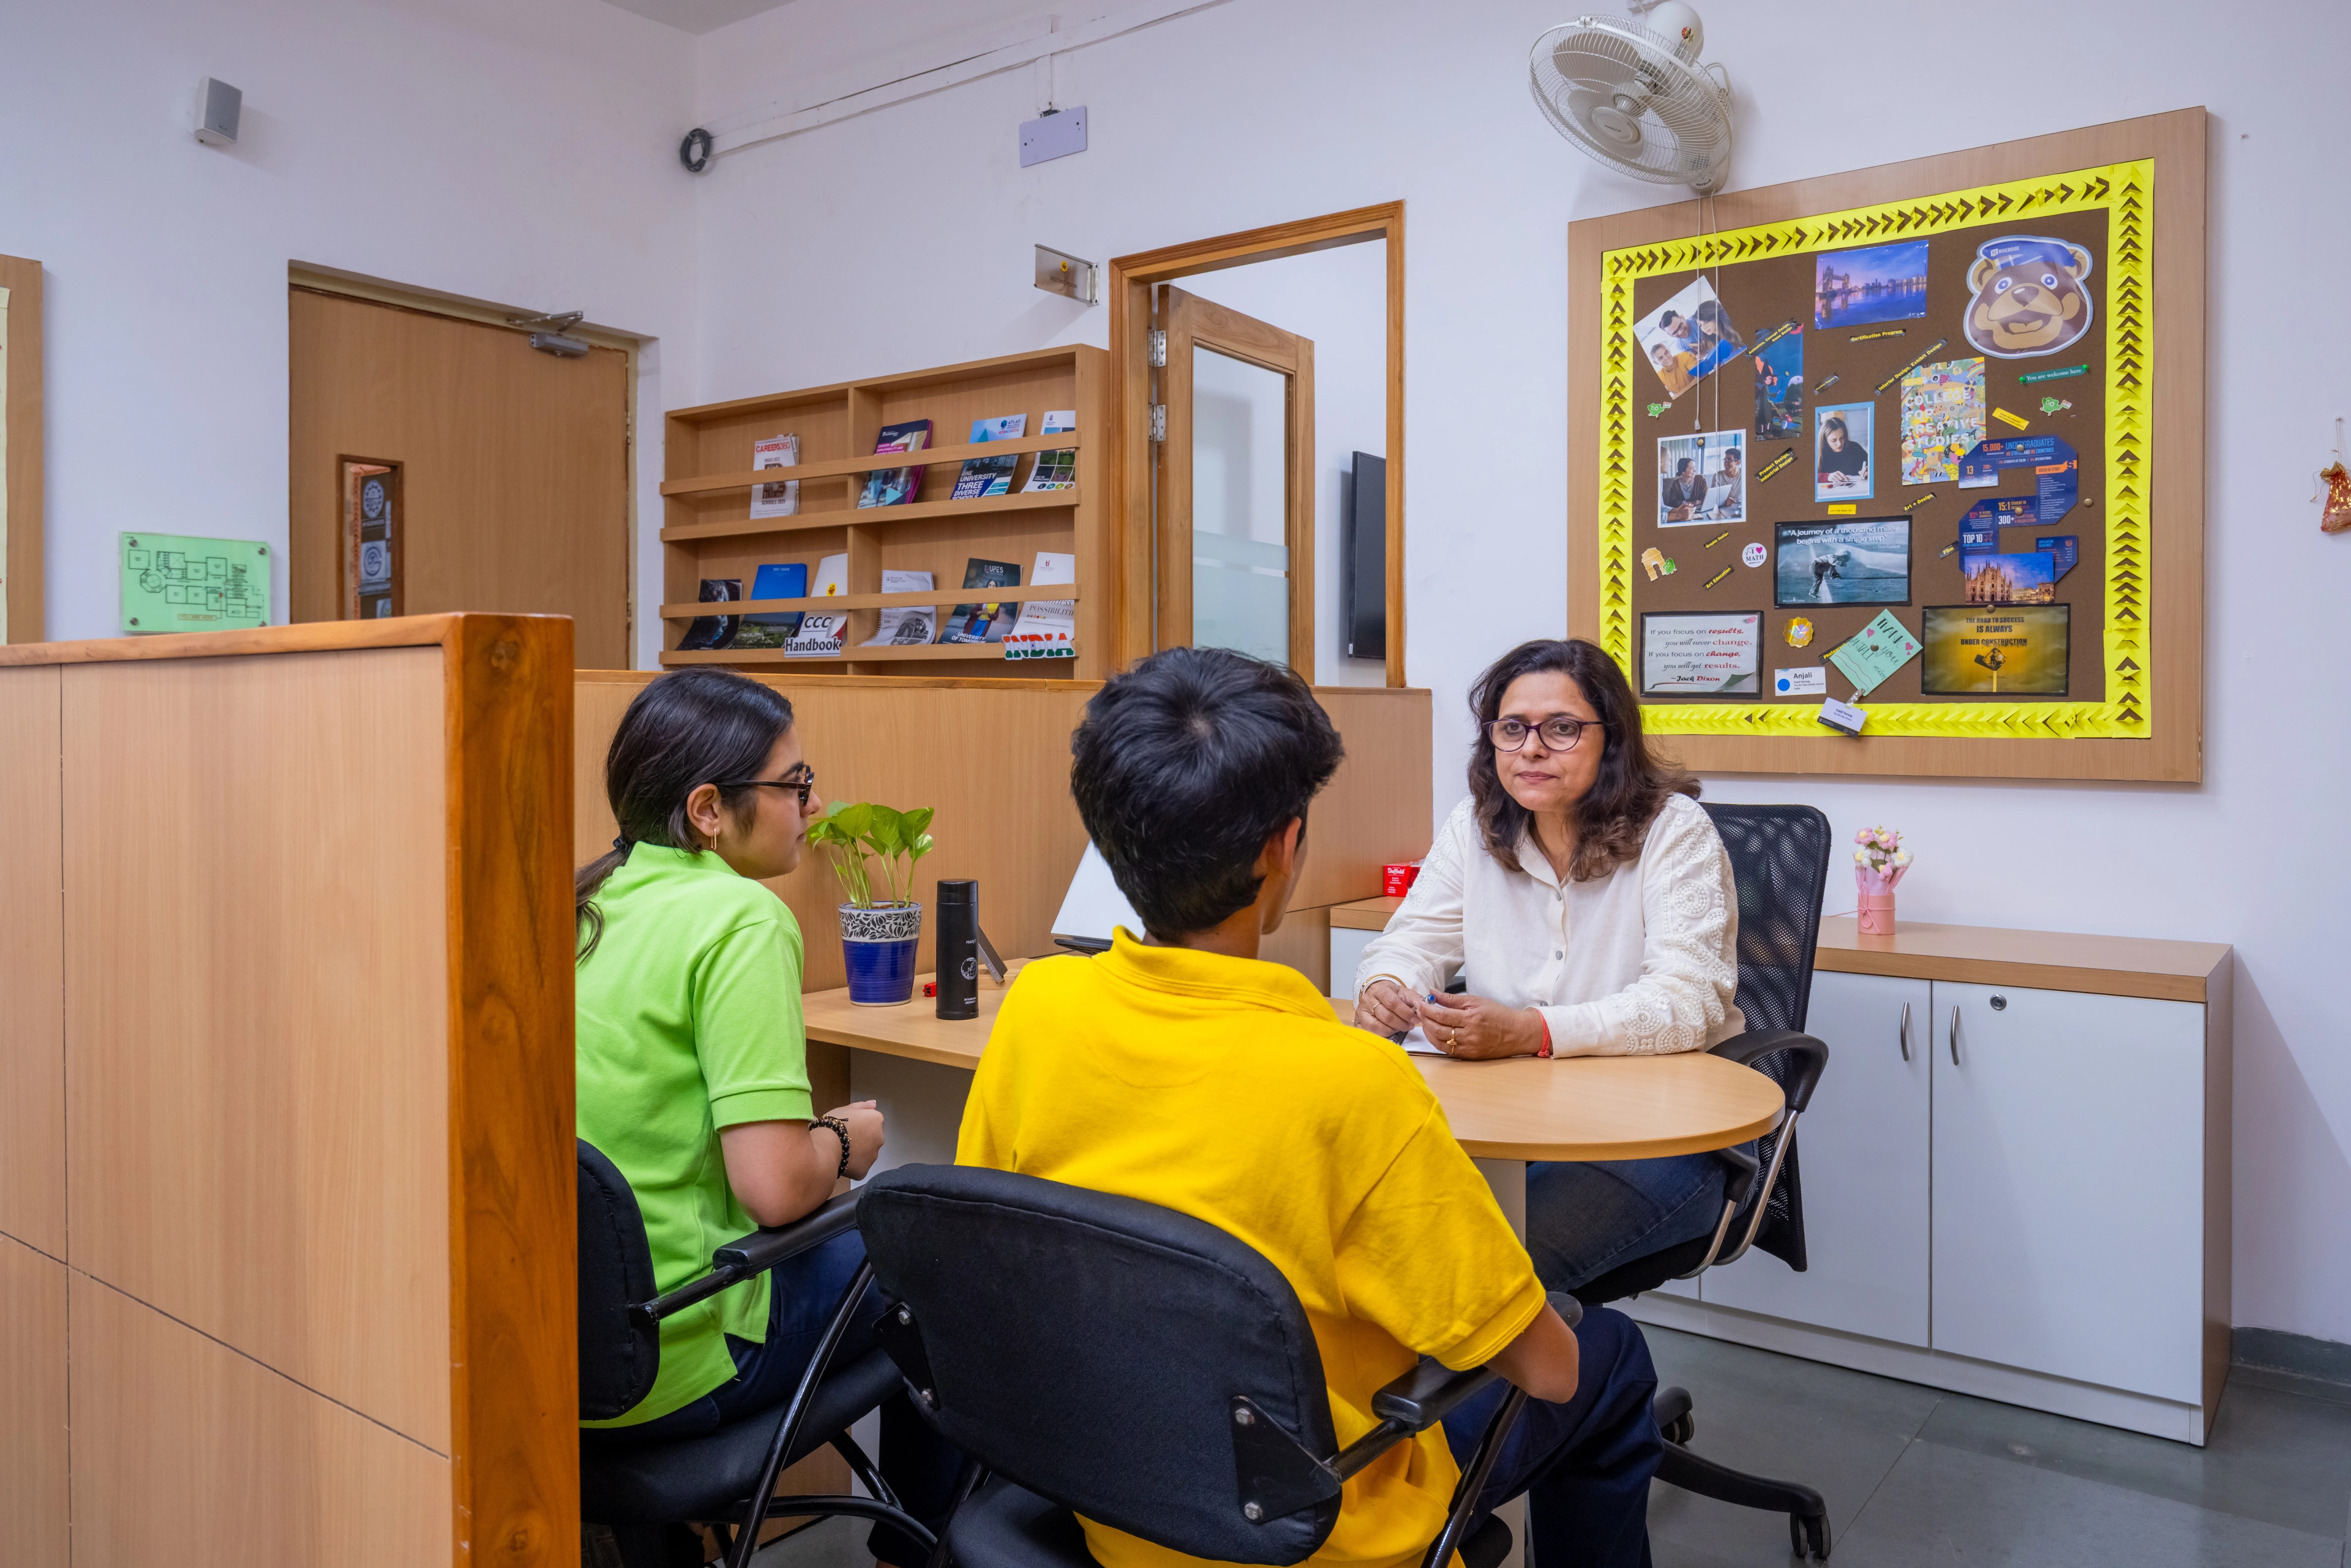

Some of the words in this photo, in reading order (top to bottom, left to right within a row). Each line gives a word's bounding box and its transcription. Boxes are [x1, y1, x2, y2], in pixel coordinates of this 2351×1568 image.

[1781, 326, 1793, 336] Design
[1749, 342, 1766, 354] Animation,
[1765, 331, 1778, 342] Concept
[1777, 323, 1790, 332] Design,
[1851, 333, 1881, 342] Certification
[1878, 377, 1895, 391] Interior
[1894, 366, 1911, 379] Design,
[1910, 353, 1927, 367] Exhibit
[1926, 343, 1943, 355] Design
[1905, 390, 1971, 407] COLLEGE
[1905, 408, 1934, 421] FOR
[1905, 416, 1979, 435] CREATIVE
[756, 441, 790, 453] CAREERS360
[1906, 433, 1970, 450] STUDIES
[1982, 443, 2004, 452] 15,000+
[1758, 463, 1775, 476] Product
[1774, 453, 1790, 464] Design,
[1760, 466, 1779, 482] Industrial
[1779, 457, 1793, 468] Design
[1966, 465, 1974, 475] 13
[959, 473, 997, 482] UNIVERSITY
[958, 481, 984, 490] THREE
[1917, 493, 1933, 504] Design
[1998, 501, 2011, 511] 15:1
[1998, 515, 2014, 525] 300+
[1705, 539, 1718, 549] Graphic
[1717, 532, 1729, 541] Design
[1962, 534, 1975, 544] TOP
[1975, 533, 1983, 543] 10
[1712, 567, 1731, 583] Education
[804, 616, 832, 629] CCC
[957, 632, 986, 640] UNIVERSITY
[1877, 616, 1907, 649] THANK
[785, 637, 840, 652] Handbook
[1003, 632, 1074, 659] INDIA
[1663, 640, 1678, 649] you
[1712, 639, 1752, 647] change.
[1662, 663, 1676, 672] you
[1689, 662, 1702, 672] get
